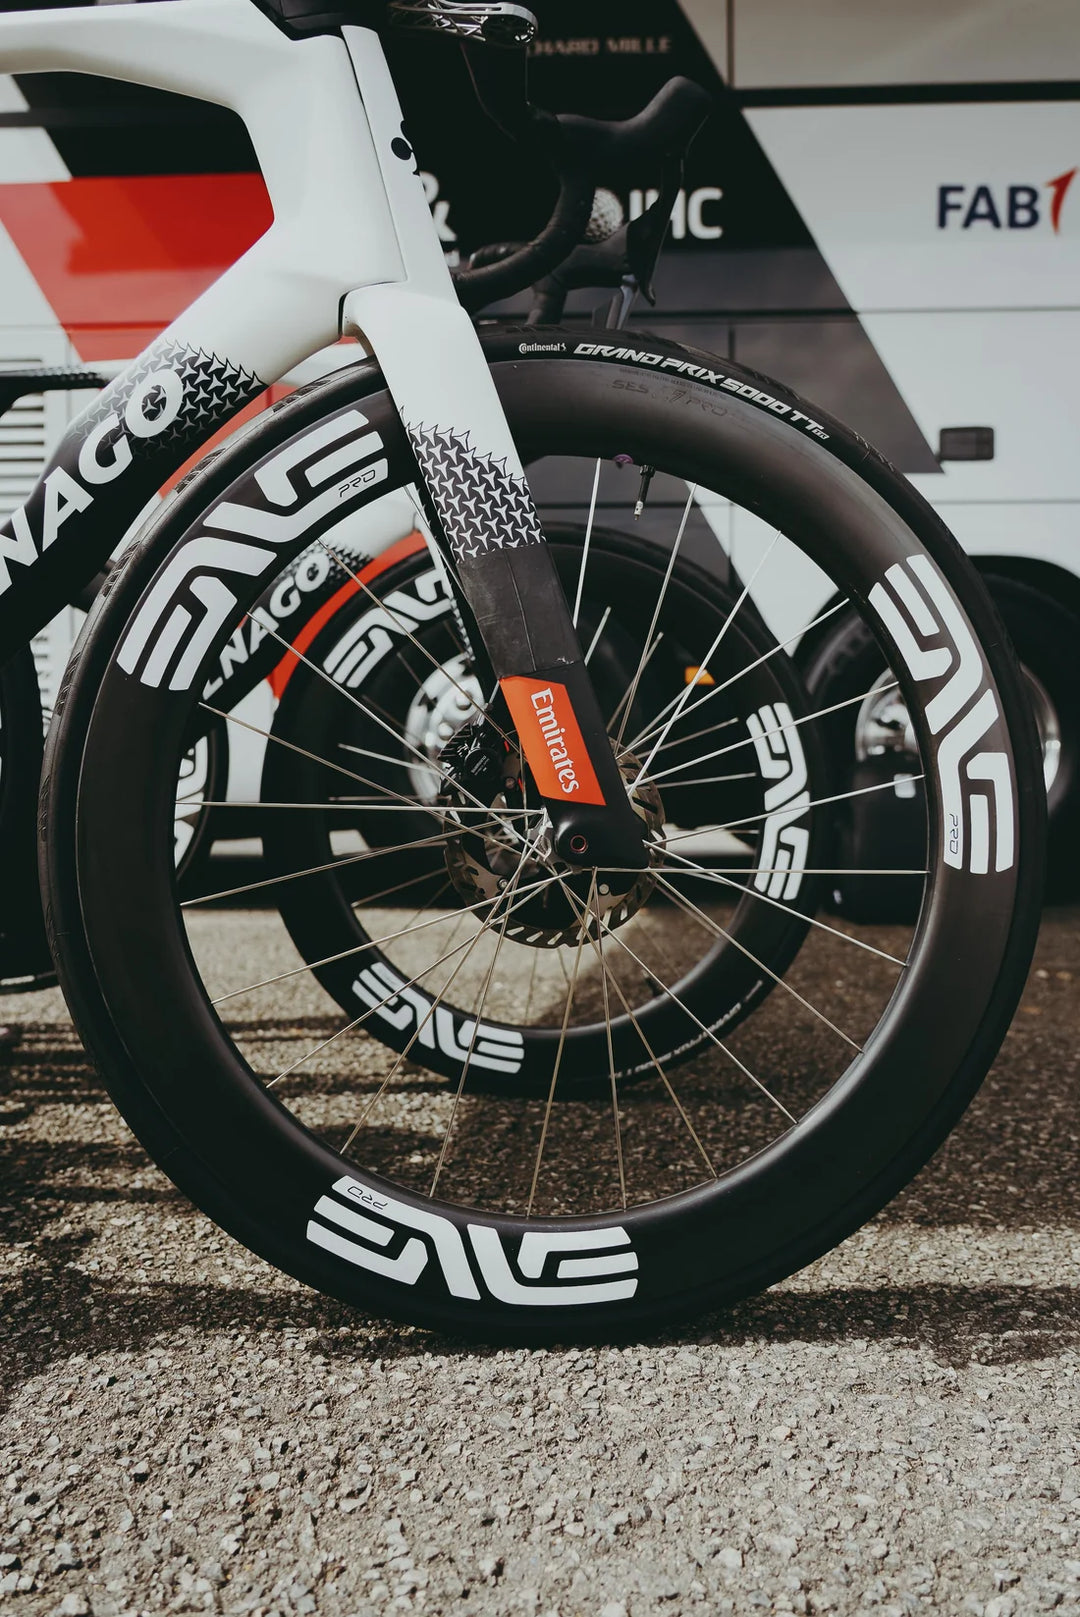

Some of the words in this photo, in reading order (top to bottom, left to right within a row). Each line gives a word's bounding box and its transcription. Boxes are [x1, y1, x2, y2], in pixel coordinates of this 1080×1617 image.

[518, 342, 561, 355] Continental
[573, 342, 664, 366] GRAND
[659, 357, 726, 385] PRIX
[719, 377, 793, 415] 5000
[790, 409, 826, 431] TT
[338, 469, 376, 498] PRO
[530, 687, 580, 794] Emirates
[948, 812, 960, 856] PRO
[347, 1185, 388, 1210] PRO
